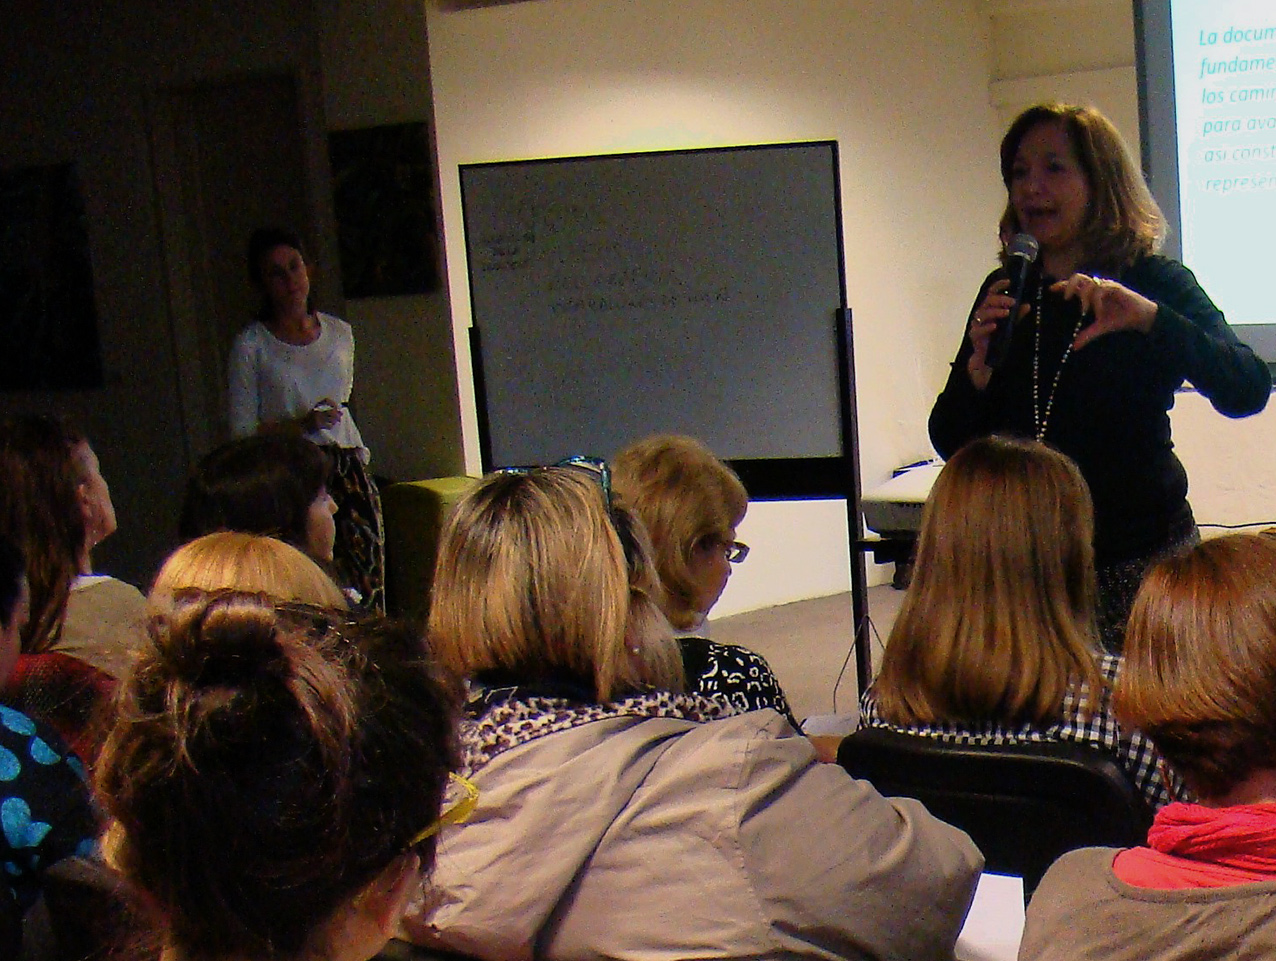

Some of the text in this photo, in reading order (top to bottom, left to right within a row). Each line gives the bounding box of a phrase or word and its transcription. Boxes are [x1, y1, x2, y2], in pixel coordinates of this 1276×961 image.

[1199, 29, 1218, 46] La
[1202, 88, 1224, 104] los
[1202, 117, 1242, 137] para
